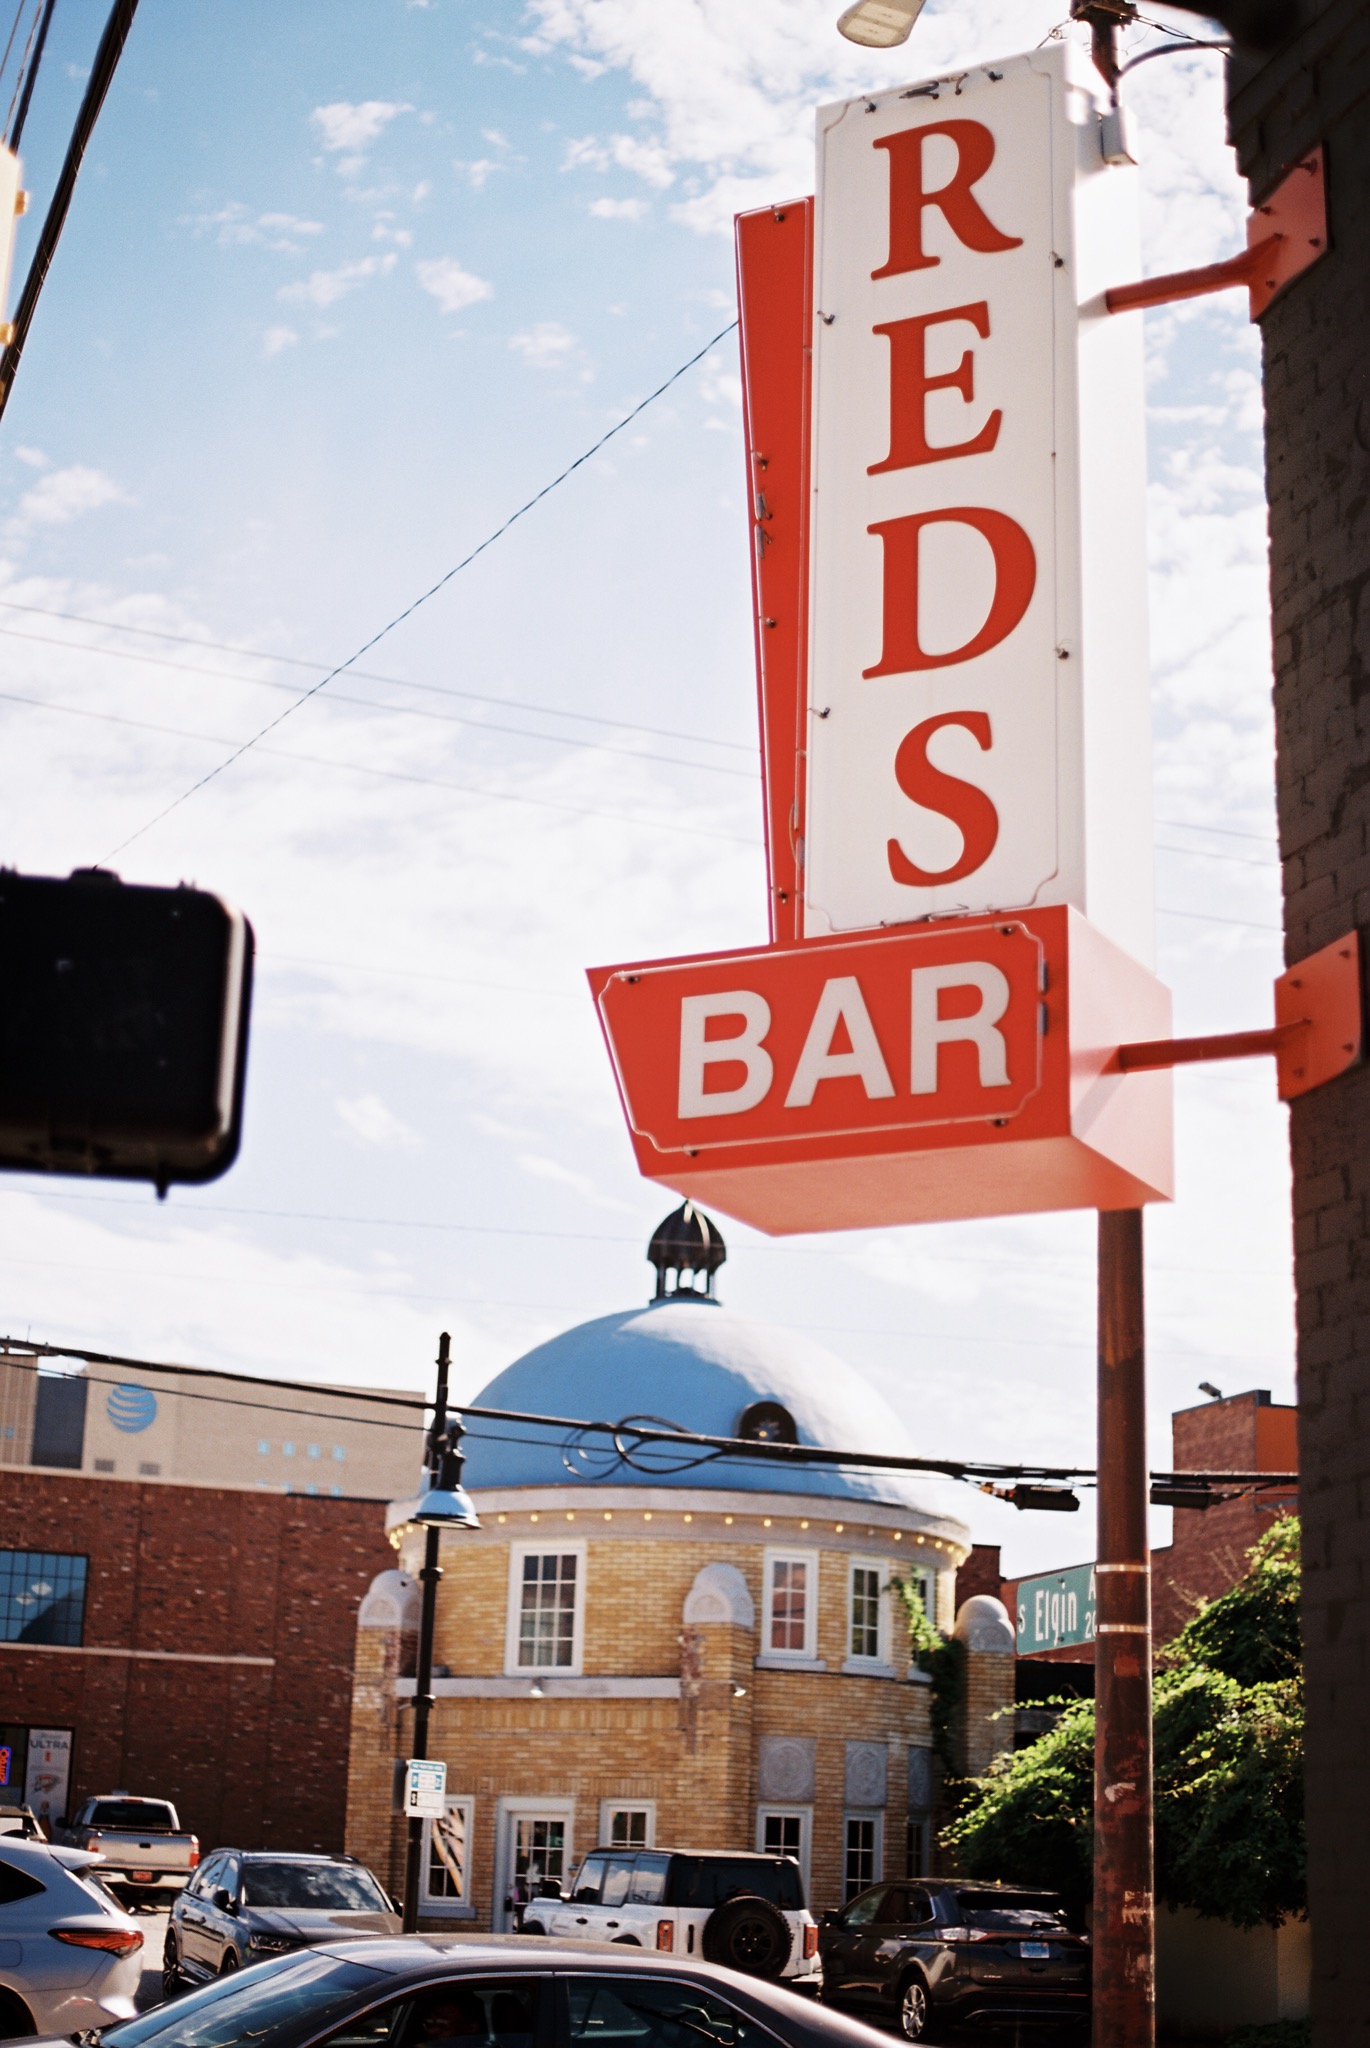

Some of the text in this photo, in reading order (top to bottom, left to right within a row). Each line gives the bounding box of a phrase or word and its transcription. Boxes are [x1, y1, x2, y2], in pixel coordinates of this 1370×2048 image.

[862, 118, 1038, 888] REDS
[677, 960, 1012, 1120] BAR
[1018, 1604, 1026, 1634] S
[1035, 1582, 1078, 1646] Elgin
[30, 1740, 69, 1749] ULTRA
